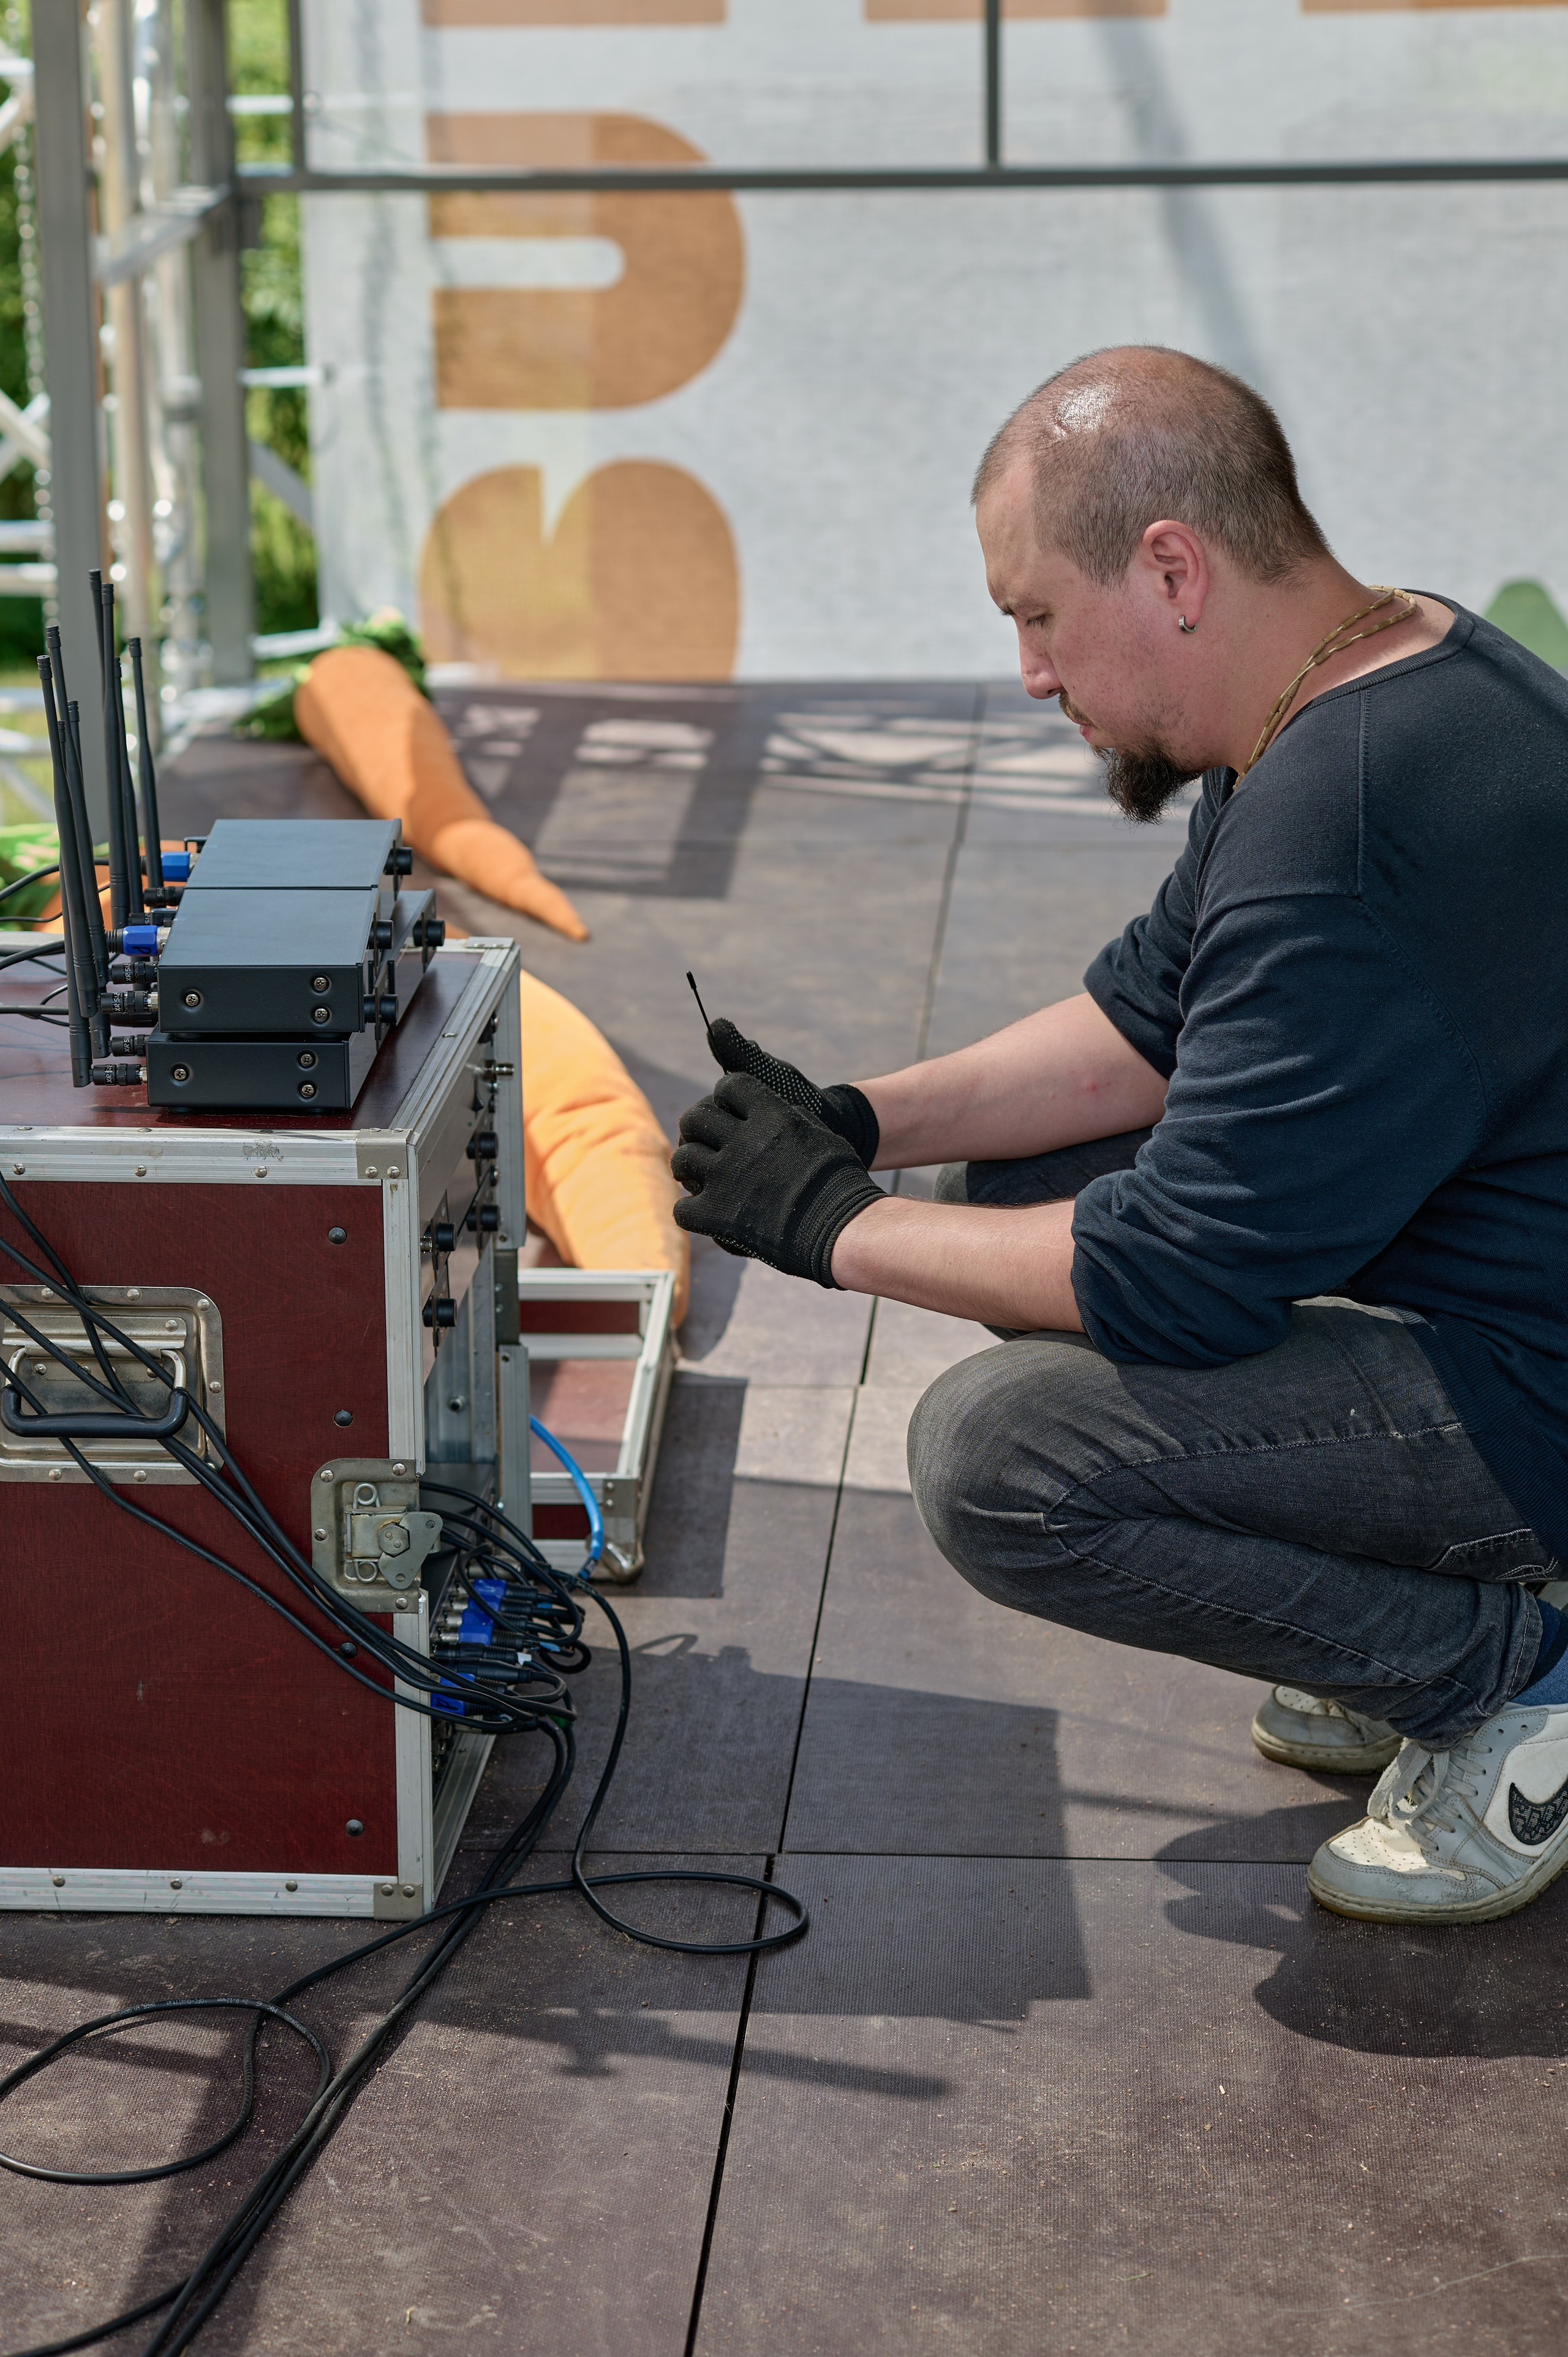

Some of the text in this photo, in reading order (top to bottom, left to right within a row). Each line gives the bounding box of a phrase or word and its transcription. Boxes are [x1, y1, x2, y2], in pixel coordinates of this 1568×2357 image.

[124, 972, 132, 982] XR
[113, 1003, 121, 1012] XR
[124, 1043, 130, 1053] XR
[106, 1074, 113, 1083] XR
[267, 2004, 279, 2014] MK
